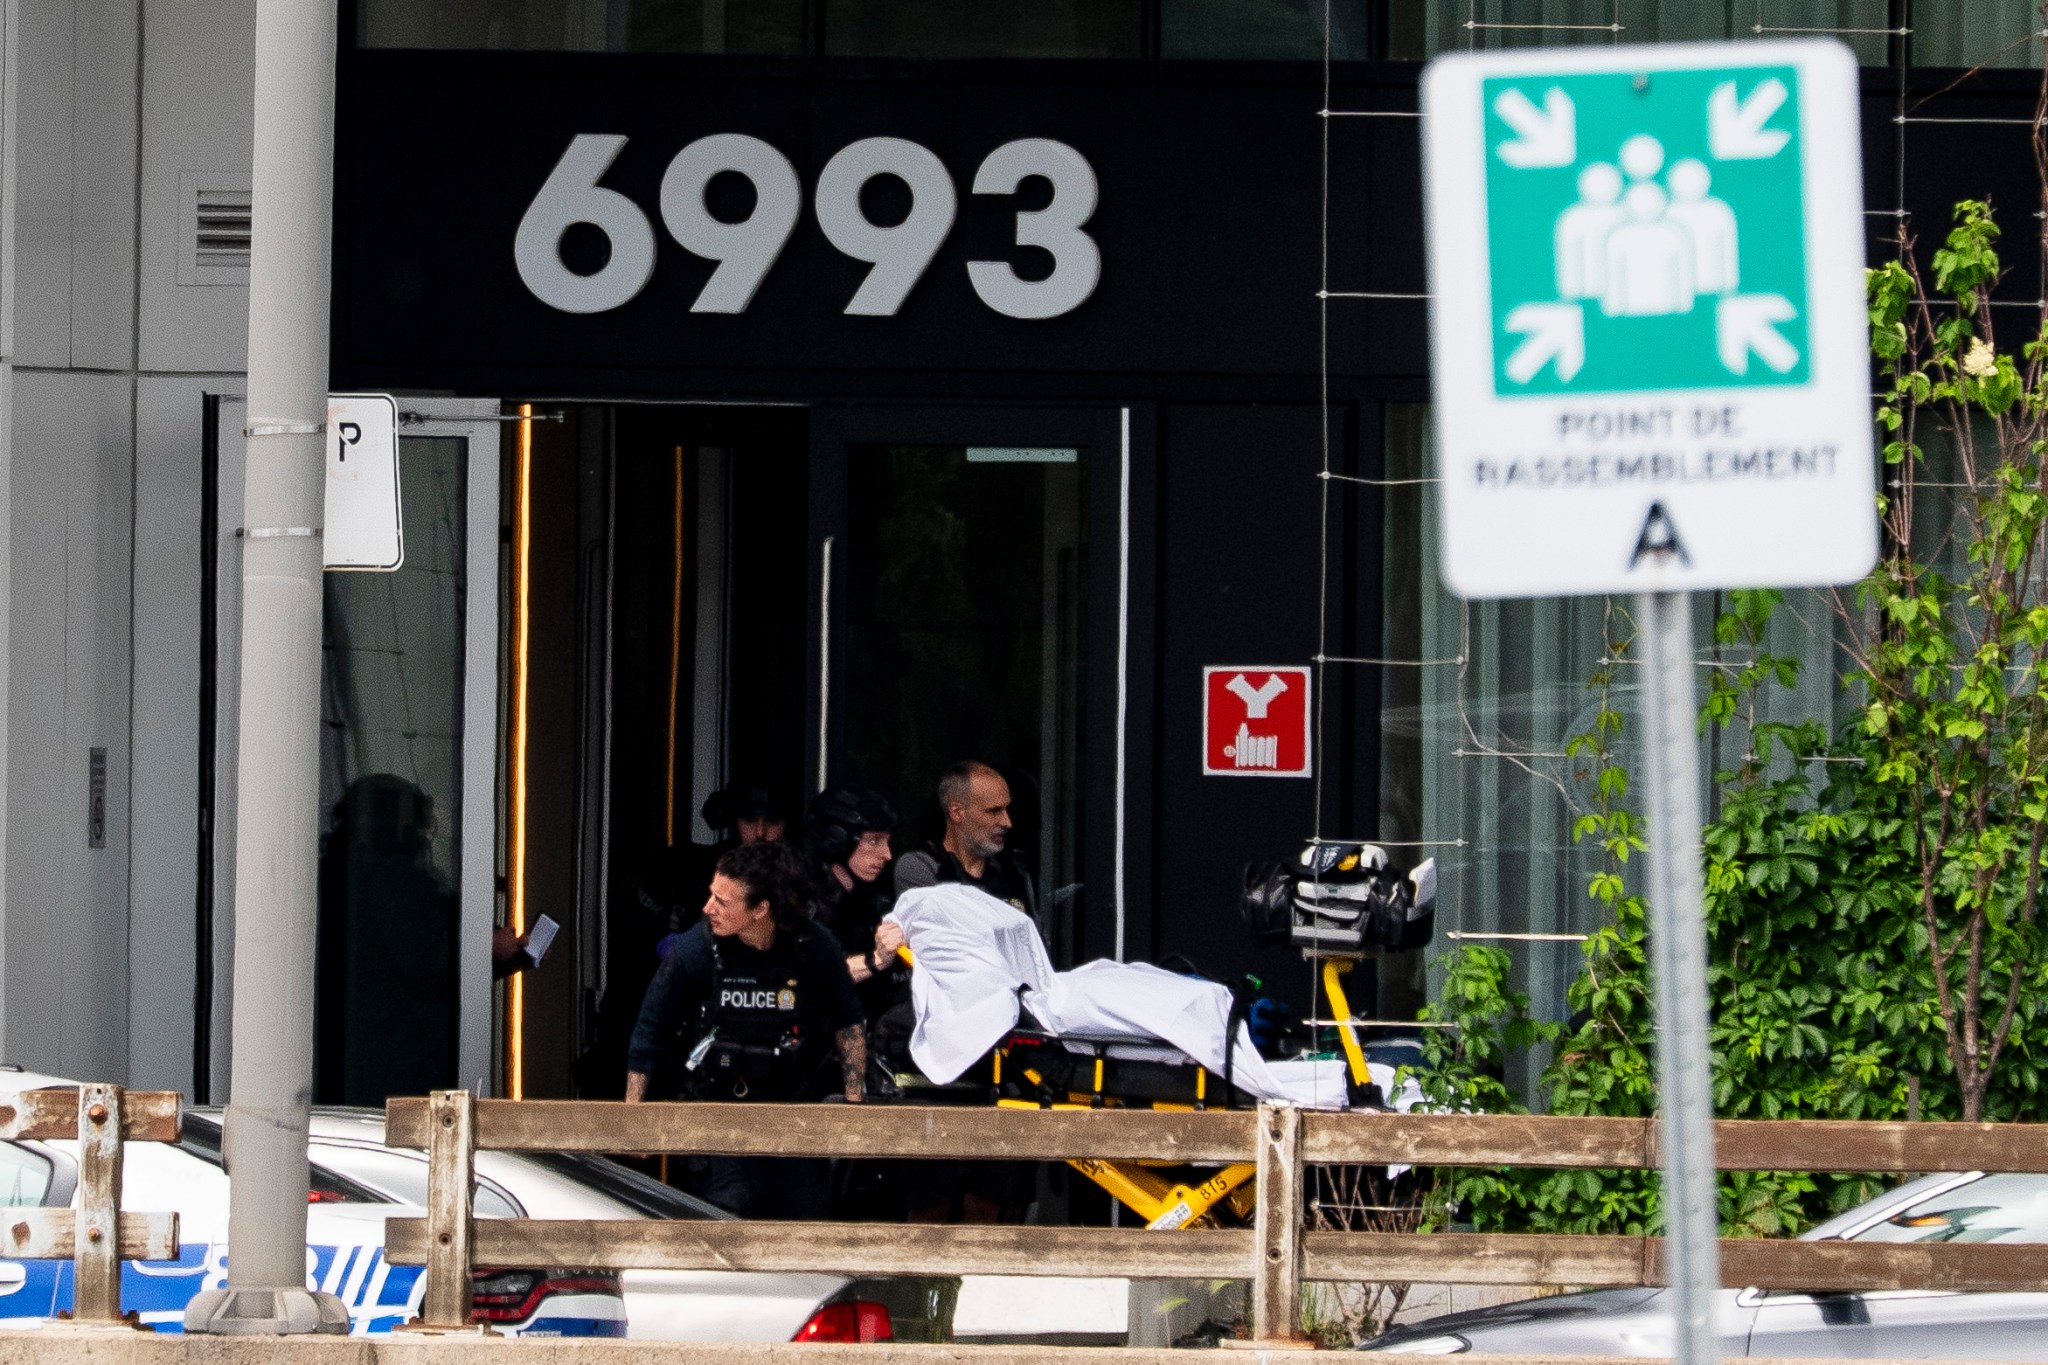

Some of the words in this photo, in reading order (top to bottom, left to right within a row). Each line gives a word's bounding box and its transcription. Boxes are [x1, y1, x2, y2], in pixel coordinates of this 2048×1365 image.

[514, 133, 1101, 319] 6993
[338, 421, 362, 462] P
[1556, 407, 1674, 441] POINT
[1692, 405, 1742, 438] DE
[1473, 444, 1841, 488] RASSEMBLEMENT
[1627, 498, 1692, 572] A
[720, 990, 776, 1009] POLICE
[1200, 1175, 1227, 1200] 815
